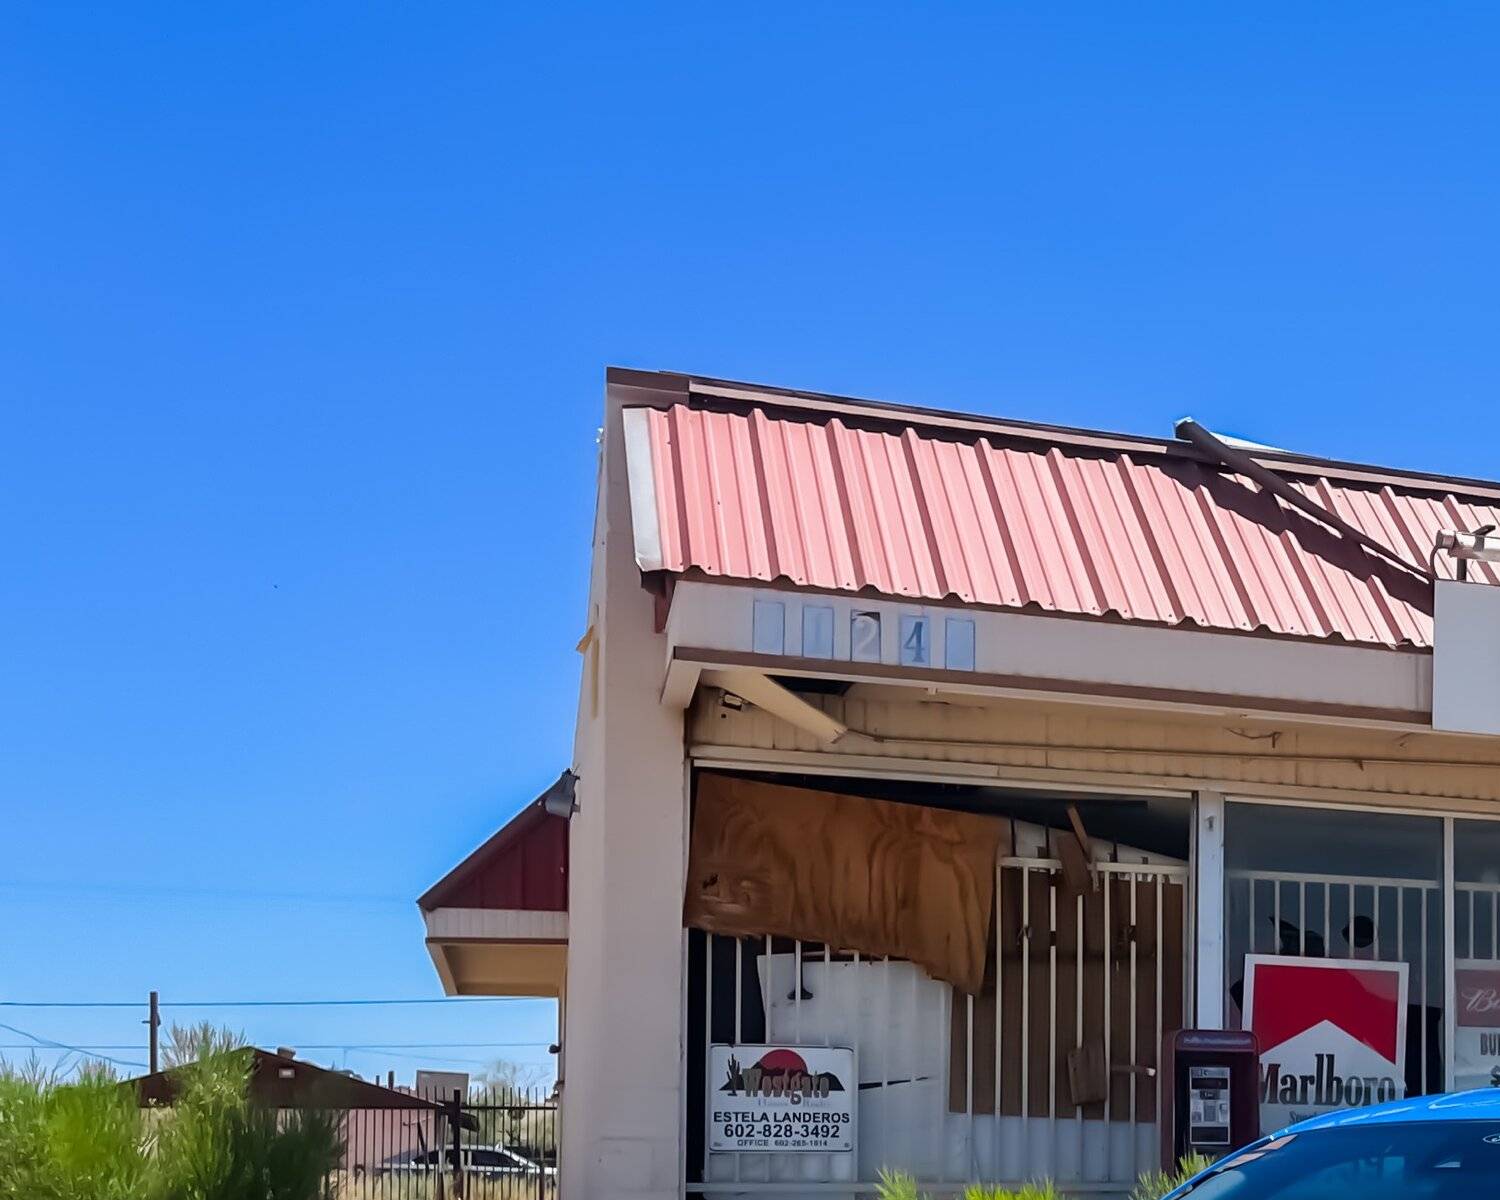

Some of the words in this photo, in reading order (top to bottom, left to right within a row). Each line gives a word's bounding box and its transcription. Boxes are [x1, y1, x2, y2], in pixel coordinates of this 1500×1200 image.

[1259, 1053, 1396, 1106] Marlboro
[713, 1112, 770, 1122] ESTELA
[773, 1112, 850, 1123] LANDEROS
[724, 1124, 840, 1138] 602-828-3492
[737, 1139, 769, 1147] OFFICE
